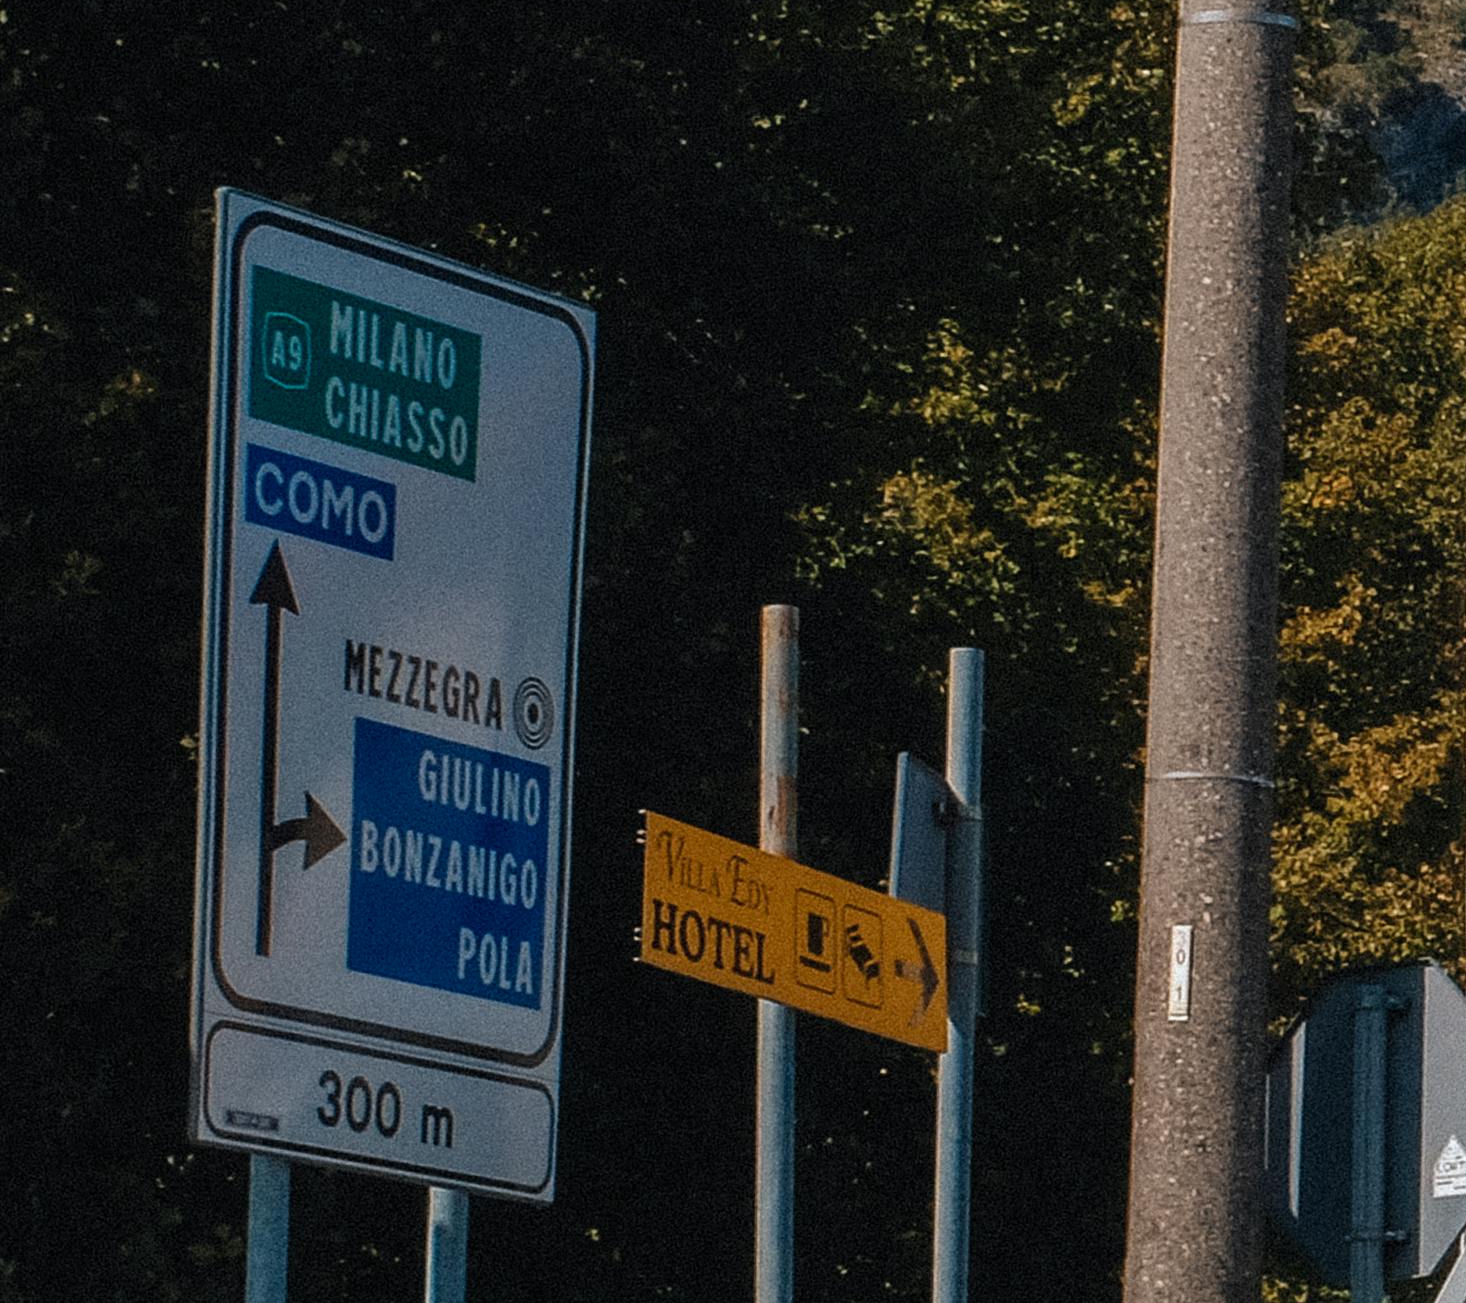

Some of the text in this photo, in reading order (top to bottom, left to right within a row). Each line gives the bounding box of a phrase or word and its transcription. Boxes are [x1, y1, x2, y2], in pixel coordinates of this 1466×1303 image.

[271, 330, 302, 370] A9
[330, 300, 456, 389] MILANO
[324, 376, 468, 466] CHIASSO
[255, 462, 387, 543] COMO
[344, 639, 502, 730] MEZZEGRA
[418, 750, 540, 826] GIULINO
[360, 820, 538, 909] BONZANIGO
[457, 927, 533, 994] POLA
[651, 898, 775, 986] HOTEL
[317, 1069, 401, 1138] 300
[421, 1104, 453, 1148] m
